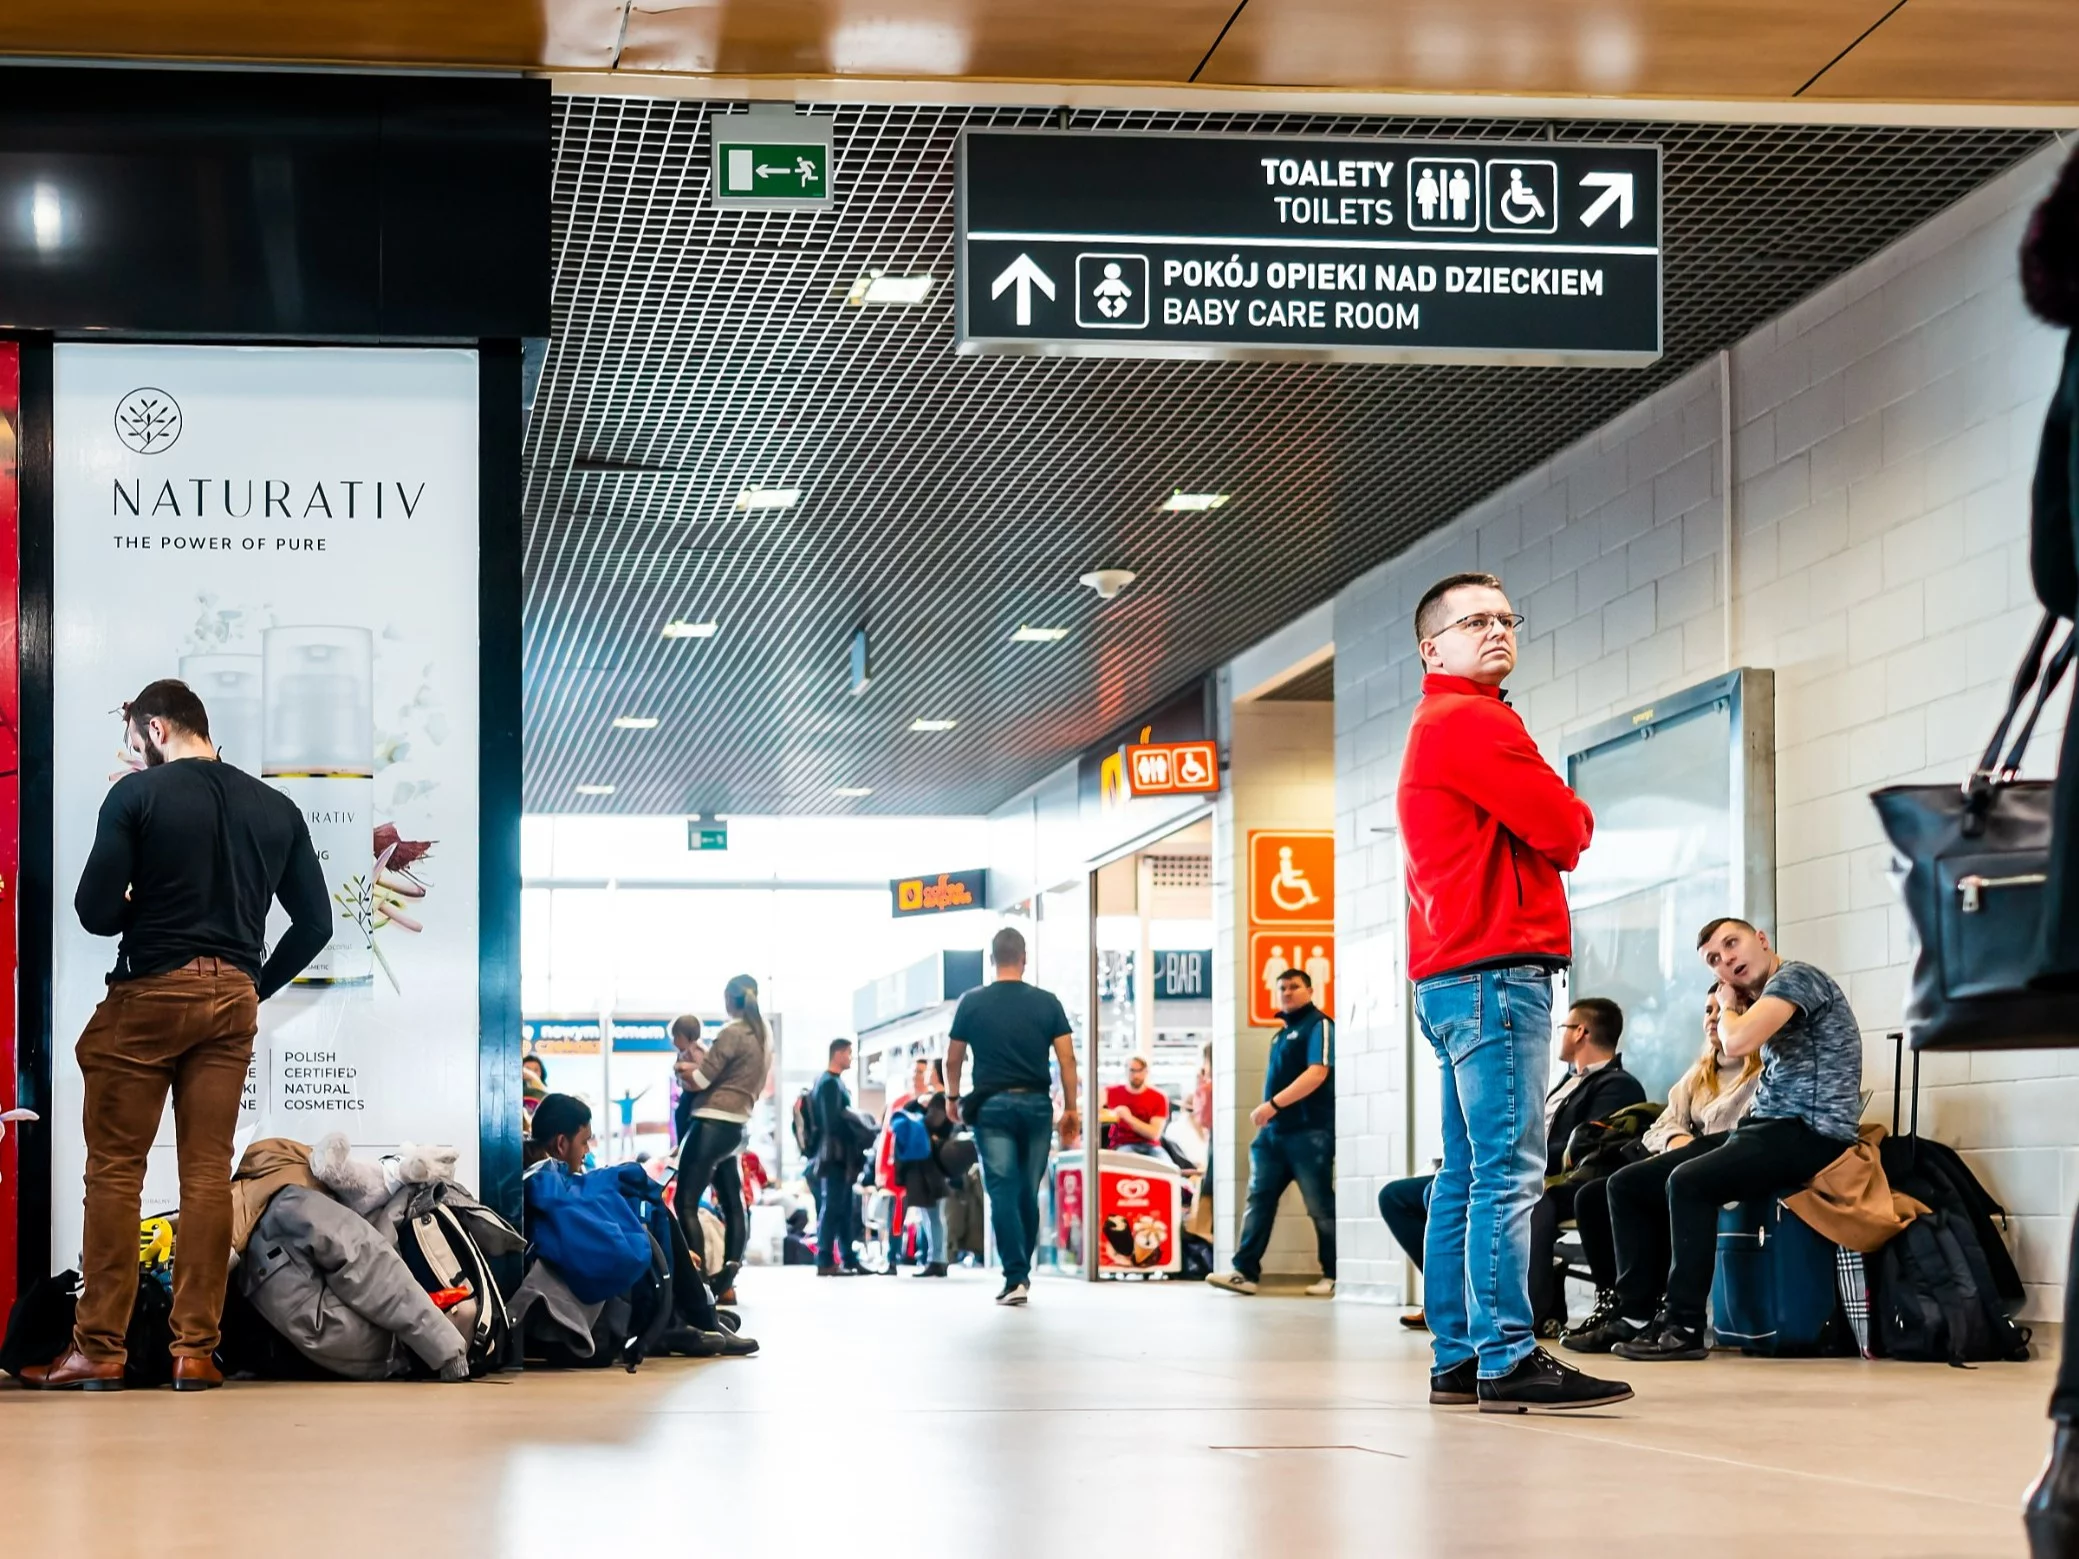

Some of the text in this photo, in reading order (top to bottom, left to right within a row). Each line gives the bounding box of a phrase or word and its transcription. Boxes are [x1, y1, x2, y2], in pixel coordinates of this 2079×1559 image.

[1261, 159, 1393, 188] TOALETY
[1274, 196, 1393, 226] TOILETS
[1163, 253, 1604, 297] POKÓJ OPIEKI NAD DZIECKIEM
[1163, 298, 1420, 330] BABY CARE ROOM
[113, 478, 426, 520] NATURATIV
[114, 536, 327, 552] THE POWER OF PURE
[1166, 952, 1202, 995] BAR
[285, 1051, 336, 1063] POLISH
[284, 1067, 357, 1079] CERTIFIED
[285, 1083, 350, 1095] NATURAL
[284, 1099, 365, 1111] COSMETICS
